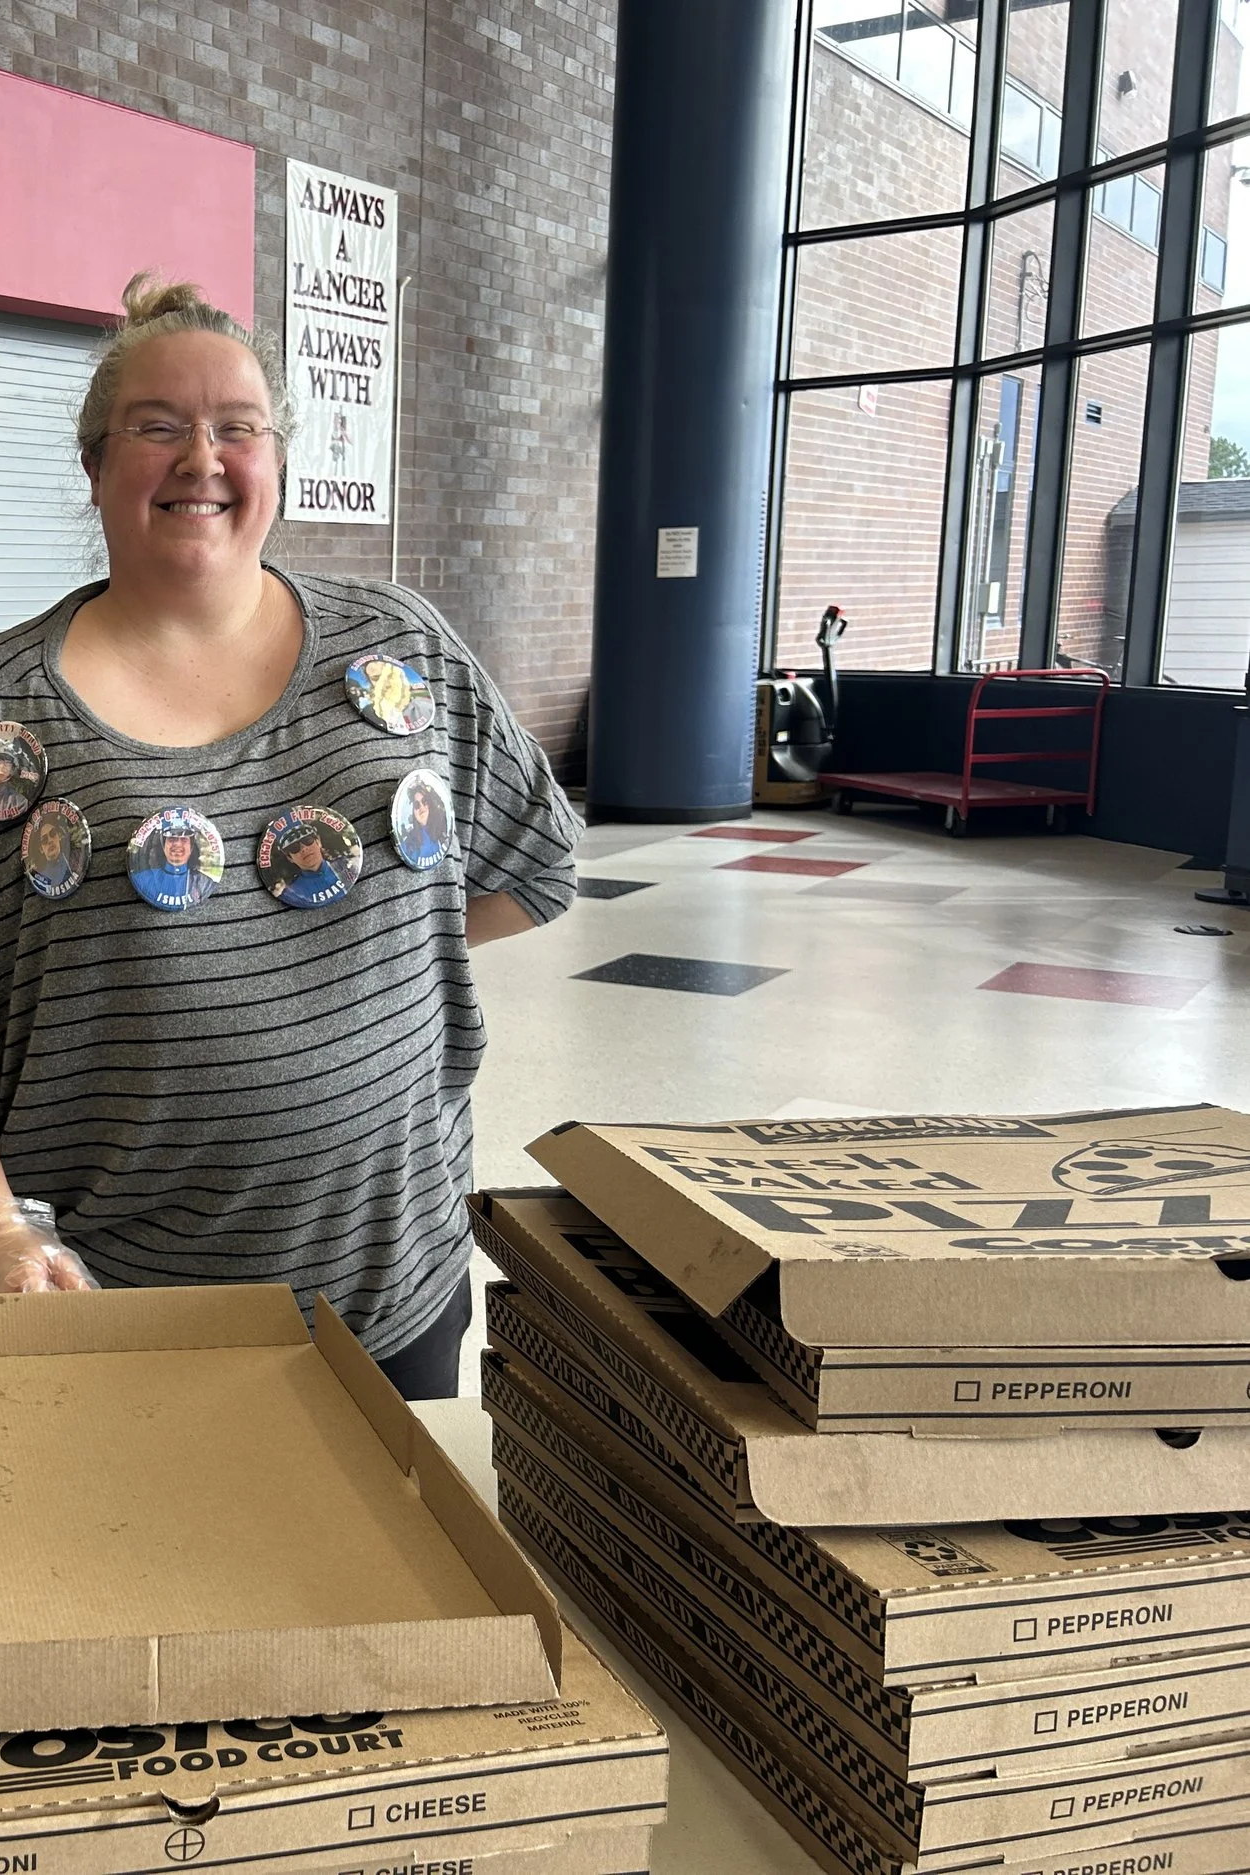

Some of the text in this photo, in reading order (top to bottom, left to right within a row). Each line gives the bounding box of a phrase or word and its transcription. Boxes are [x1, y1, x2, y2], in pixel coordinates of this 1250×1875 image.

[300, 177, 386, 231] ALWAYS
[335, 229, 352, 263] A
[293, 262, 387, 313] LANCER
[298, 323, 382, 371] ALWAYS
[308, 365, 372, 406] WITH
[298, 477, 376, 513] HONOR
[290, 809, 315, 822] FIRE
[320, 811, 346, 833] 2025
[312, 880, 346, 904] ISAAC
[754, 1117, 1021, 1137] KIRKLAND
[948, 1235, 1250, 1251] COST
[992, 1381, 1132, 1400] PEPPERONI
[618, 1486, 681, 1551] BAKED
[631, 1564, 695, 1630] BAKED
[1047, 1603, 1174, 1637] PEPPERONI
[623, 1619, 684, 1689] BAKED
[493, 1699, 591, 1720] MADE WITH 100%
[517, 1710, 580, 1725] RECYCLED
[527, 1719, 587, 1732] MATERIAL
[1067, 1691, 1189, 1728] PEPPERONI
[117, 1728, 405, 1781] FOOD COURT
[385, 1792, 487, 1824] CHEESE
[1082, 1776, 1204, 1813] PEPPERONI
